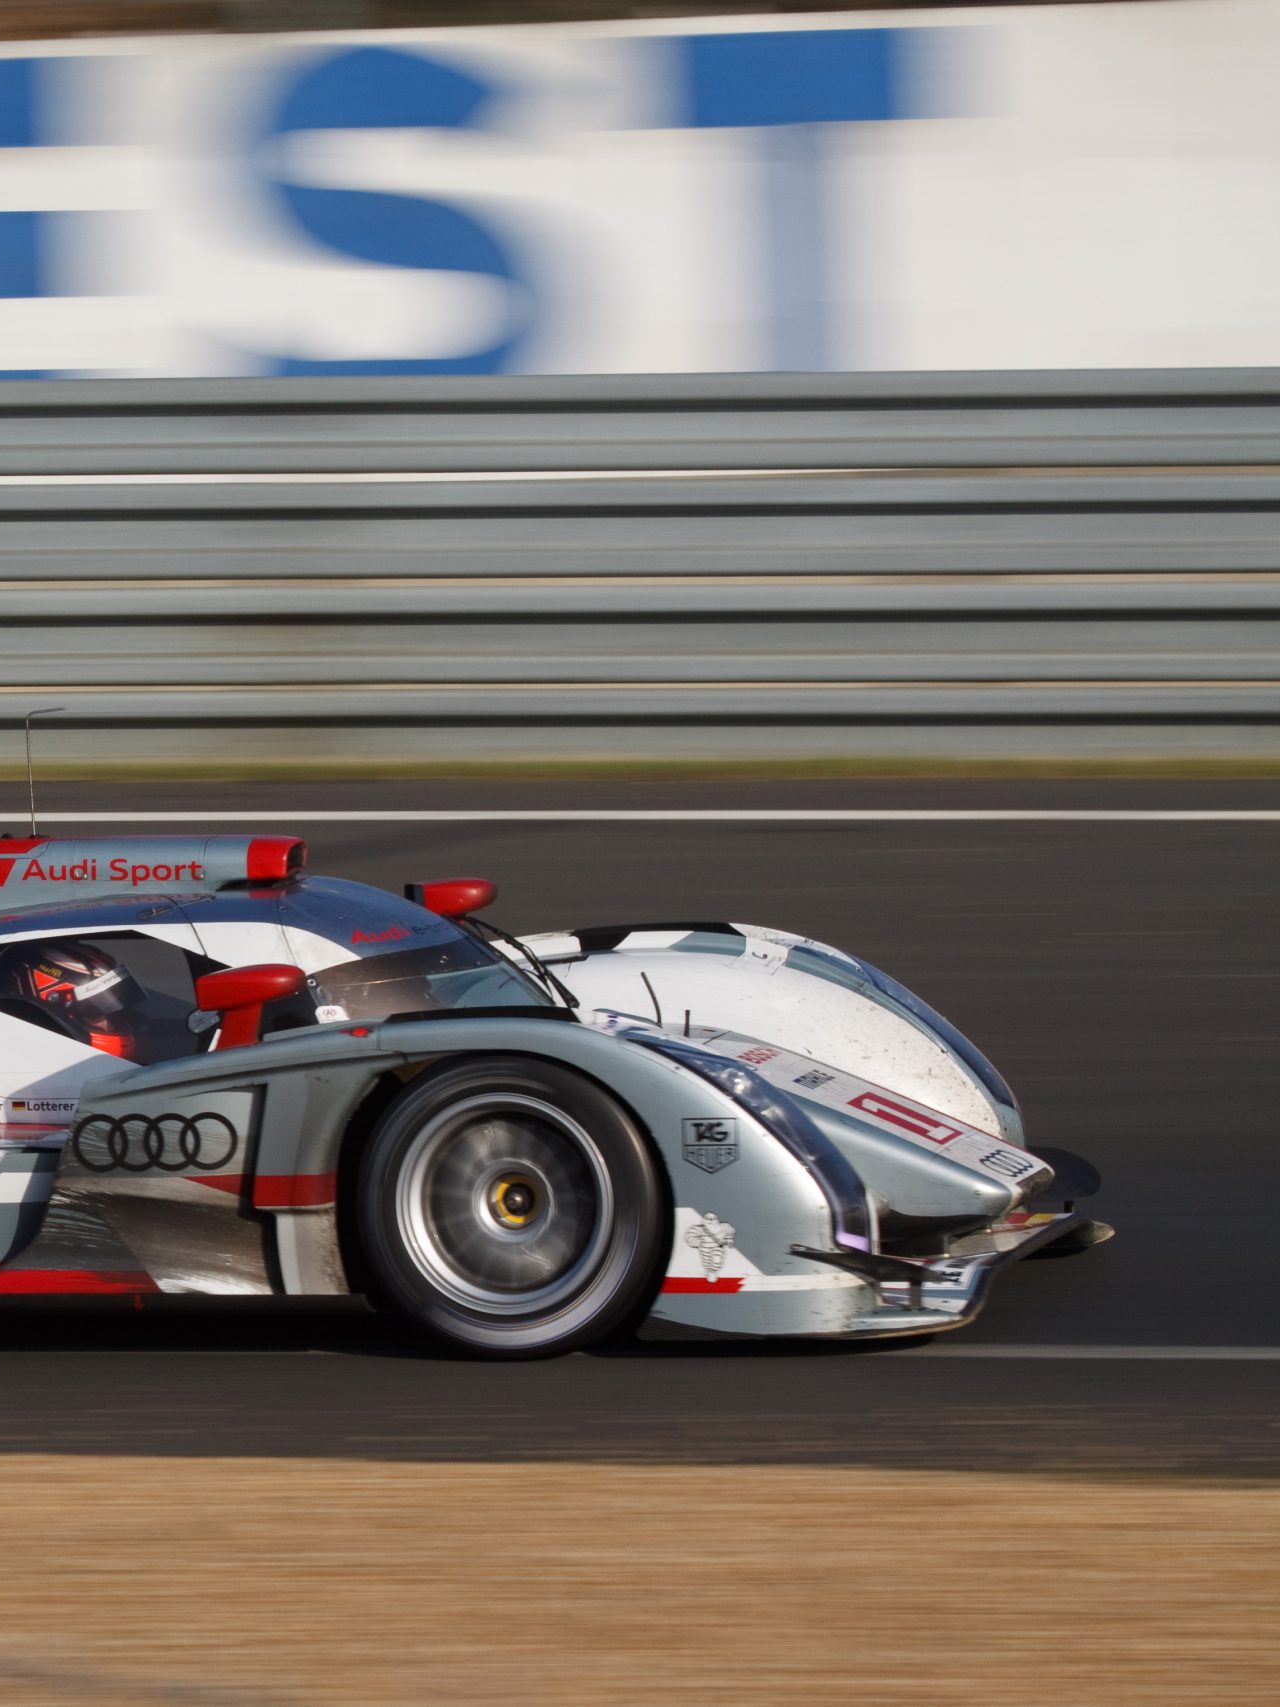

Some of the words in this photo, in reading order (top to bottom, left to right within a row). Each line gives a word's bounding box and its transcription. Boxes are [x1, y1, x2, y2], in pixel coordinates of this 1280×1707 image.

[22, 858, 97, 882] Audi
[110, 858, 202, 887] Sport
[352, 927, 411, 944] Audi
[27, 1101, 75, 1111] Lotterer
[862, 1098, 956, 1141] 1
[691, 1122, 729, 1142] TAG
